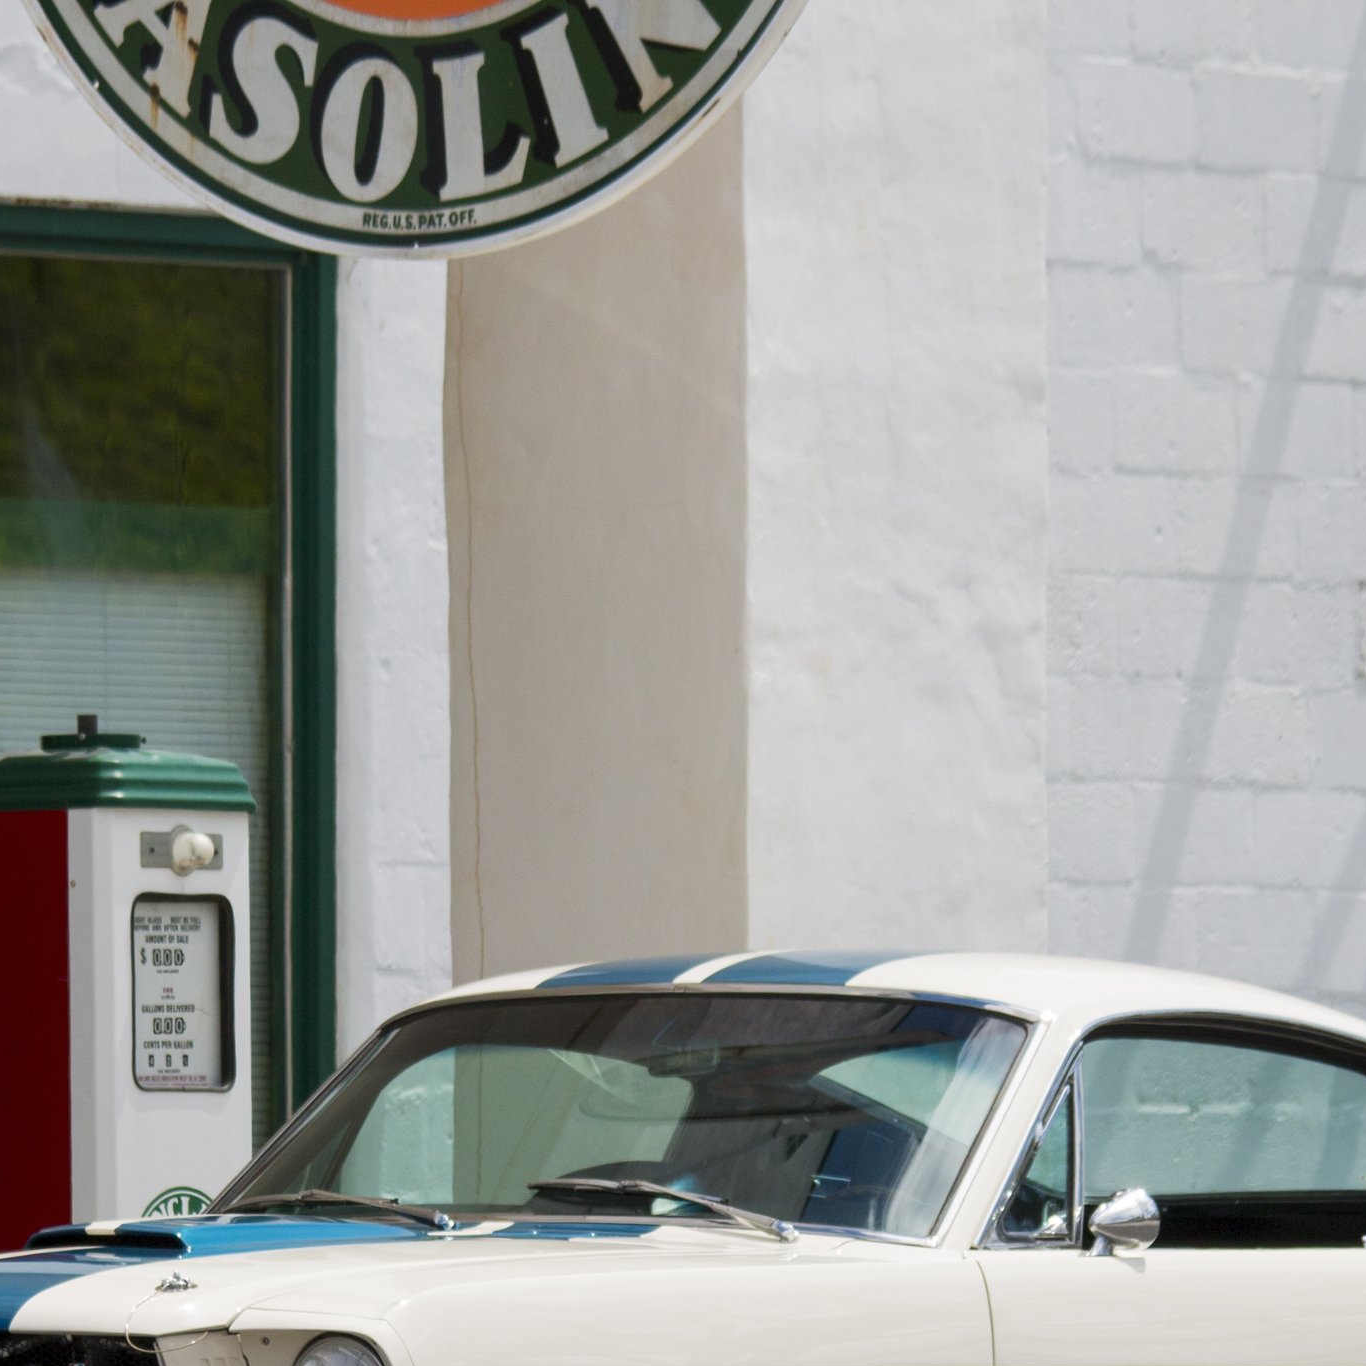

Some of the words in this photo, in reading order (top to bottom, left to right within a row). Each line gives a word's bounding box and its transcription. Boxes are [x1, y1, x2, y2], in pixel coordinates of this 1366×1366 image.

[145, 935, 167, 944] AMOUNT
[168, 935, 175, 944] OF
[177, 935, 189, 944] SALE
[140, 948, 147, 965] $
[141, 1004, 165, 1013] GALLONS
[166, 1004, 195, 1013] DELIVERED
[143, 1041, 160, 1050] CENTS
[161, 1040, 172, 1049] PER
[173, 1040, 194, 1050] GALLON
